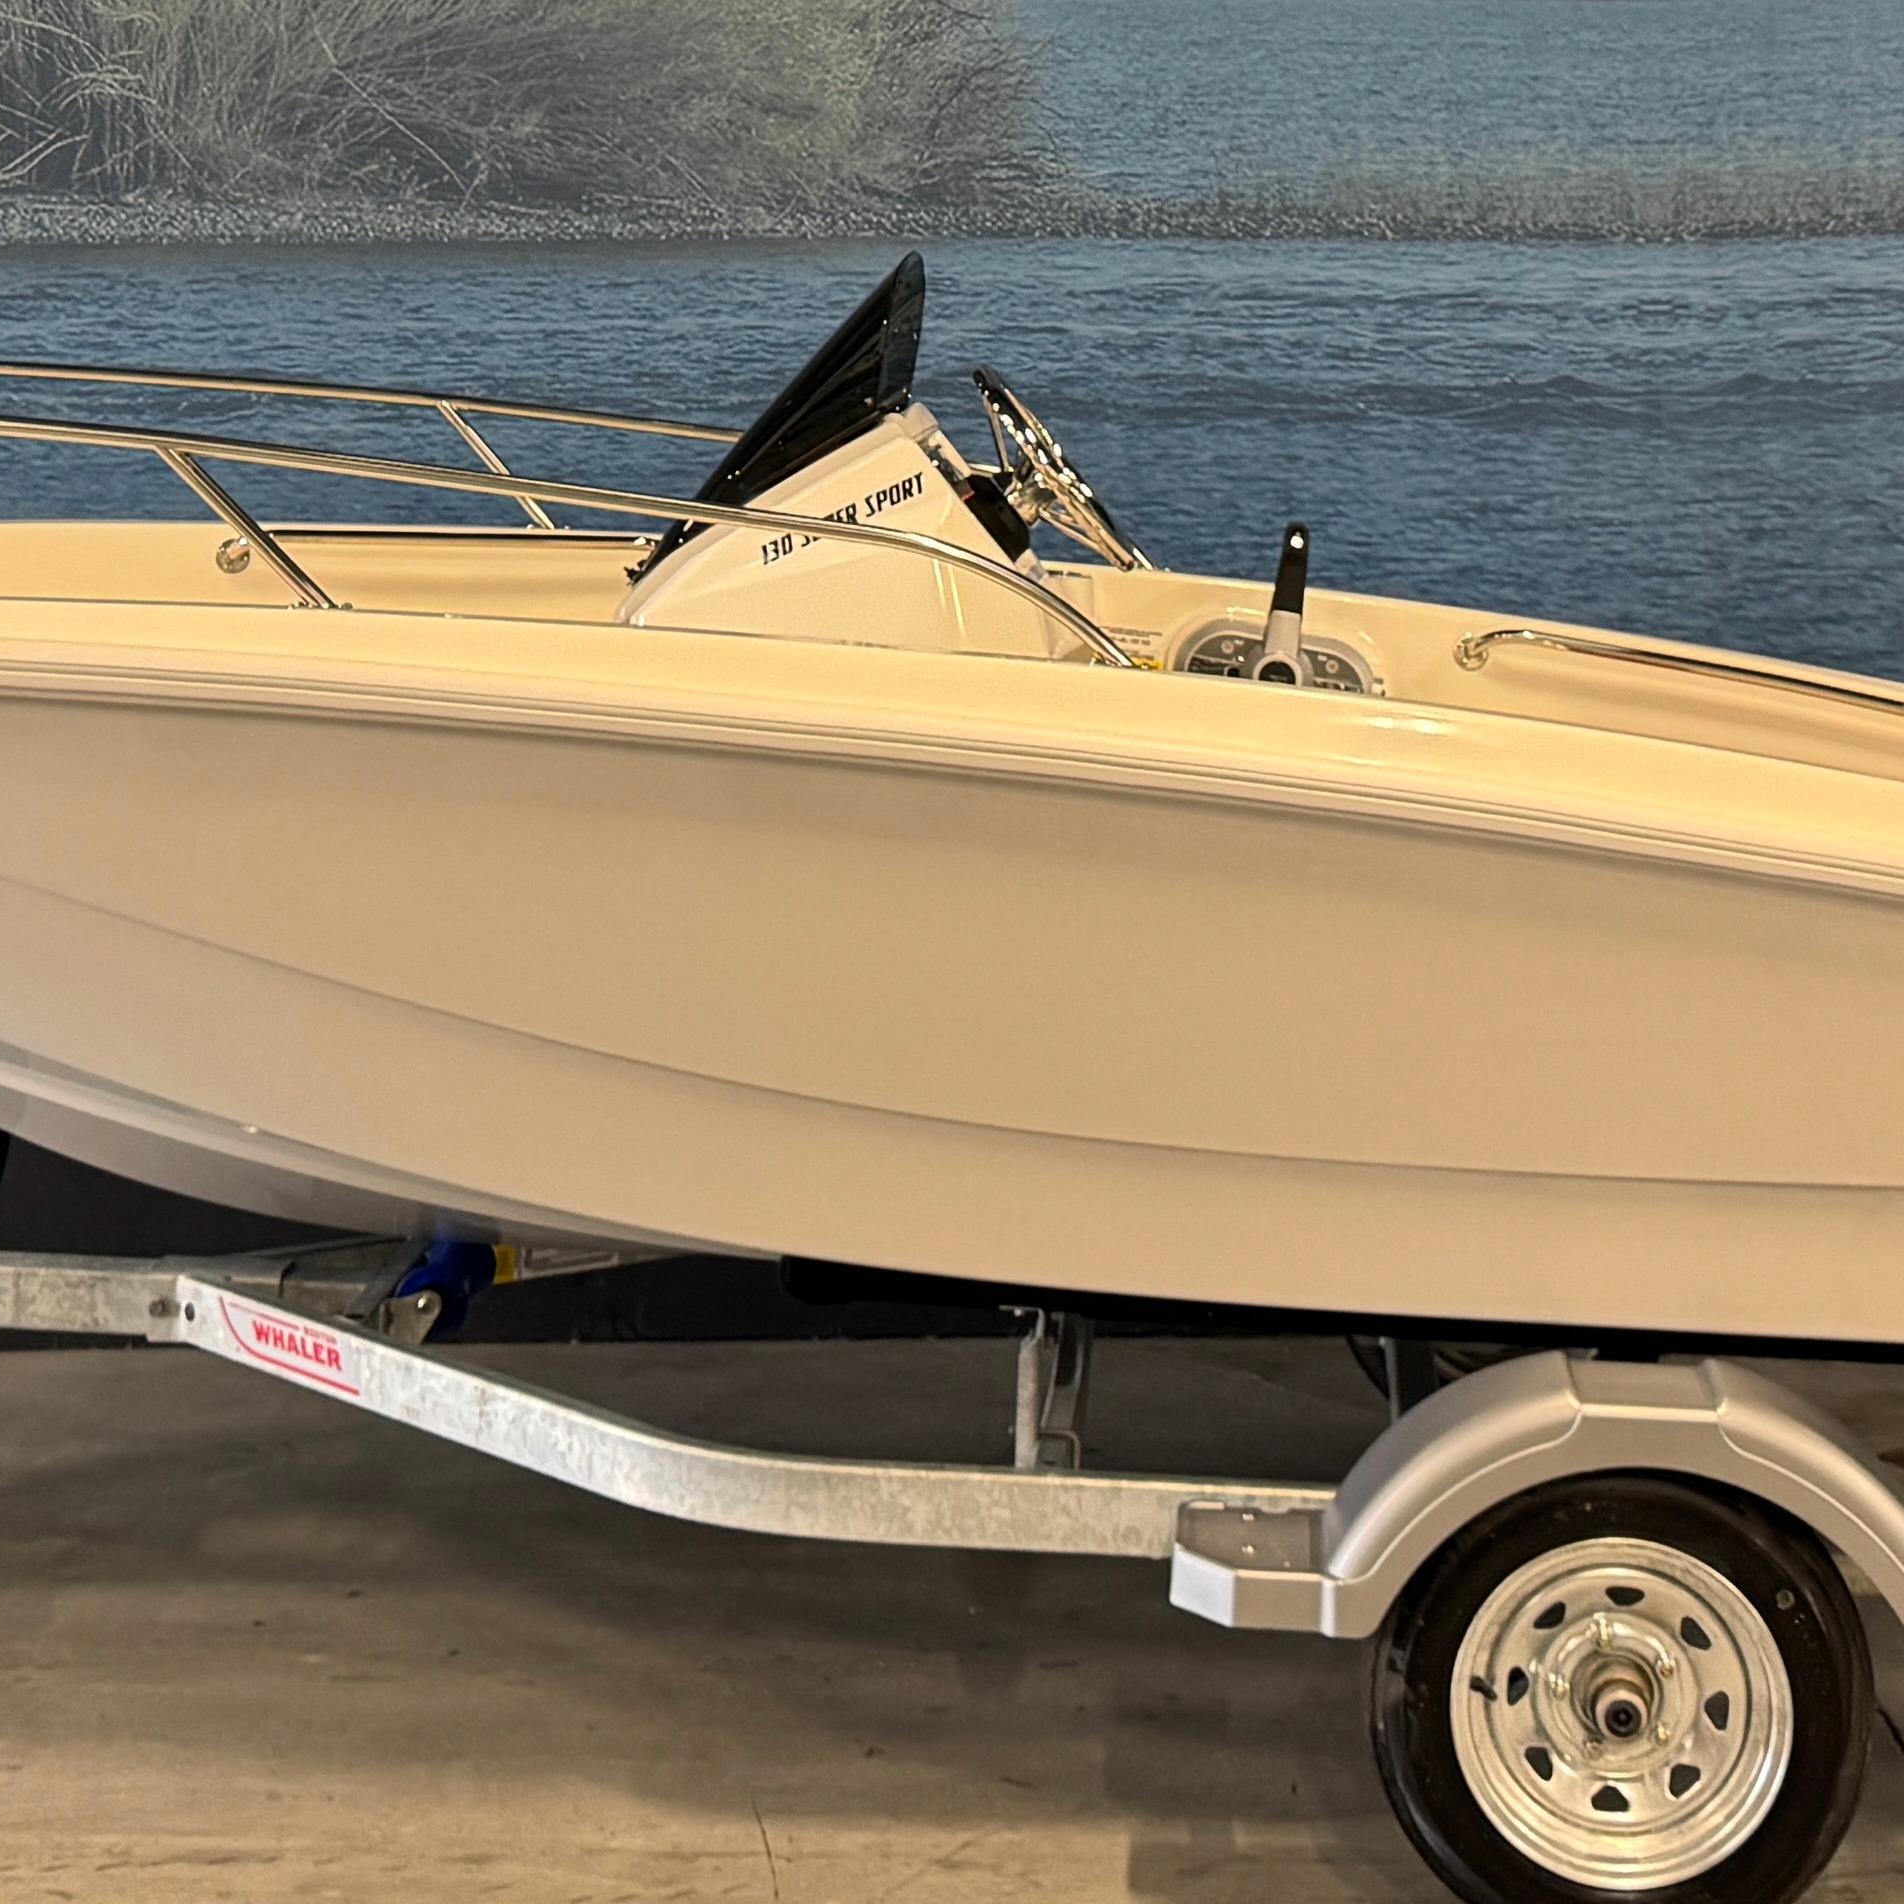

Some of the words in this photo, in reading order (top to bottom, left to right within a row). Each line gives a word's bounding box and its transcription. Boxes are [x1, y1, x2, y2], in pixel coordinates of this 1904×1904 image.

[761, 533, 793, 565] 130
[864, 471, 924, 518] SPORT
[252, 1319, 343, 1372] WHALER
